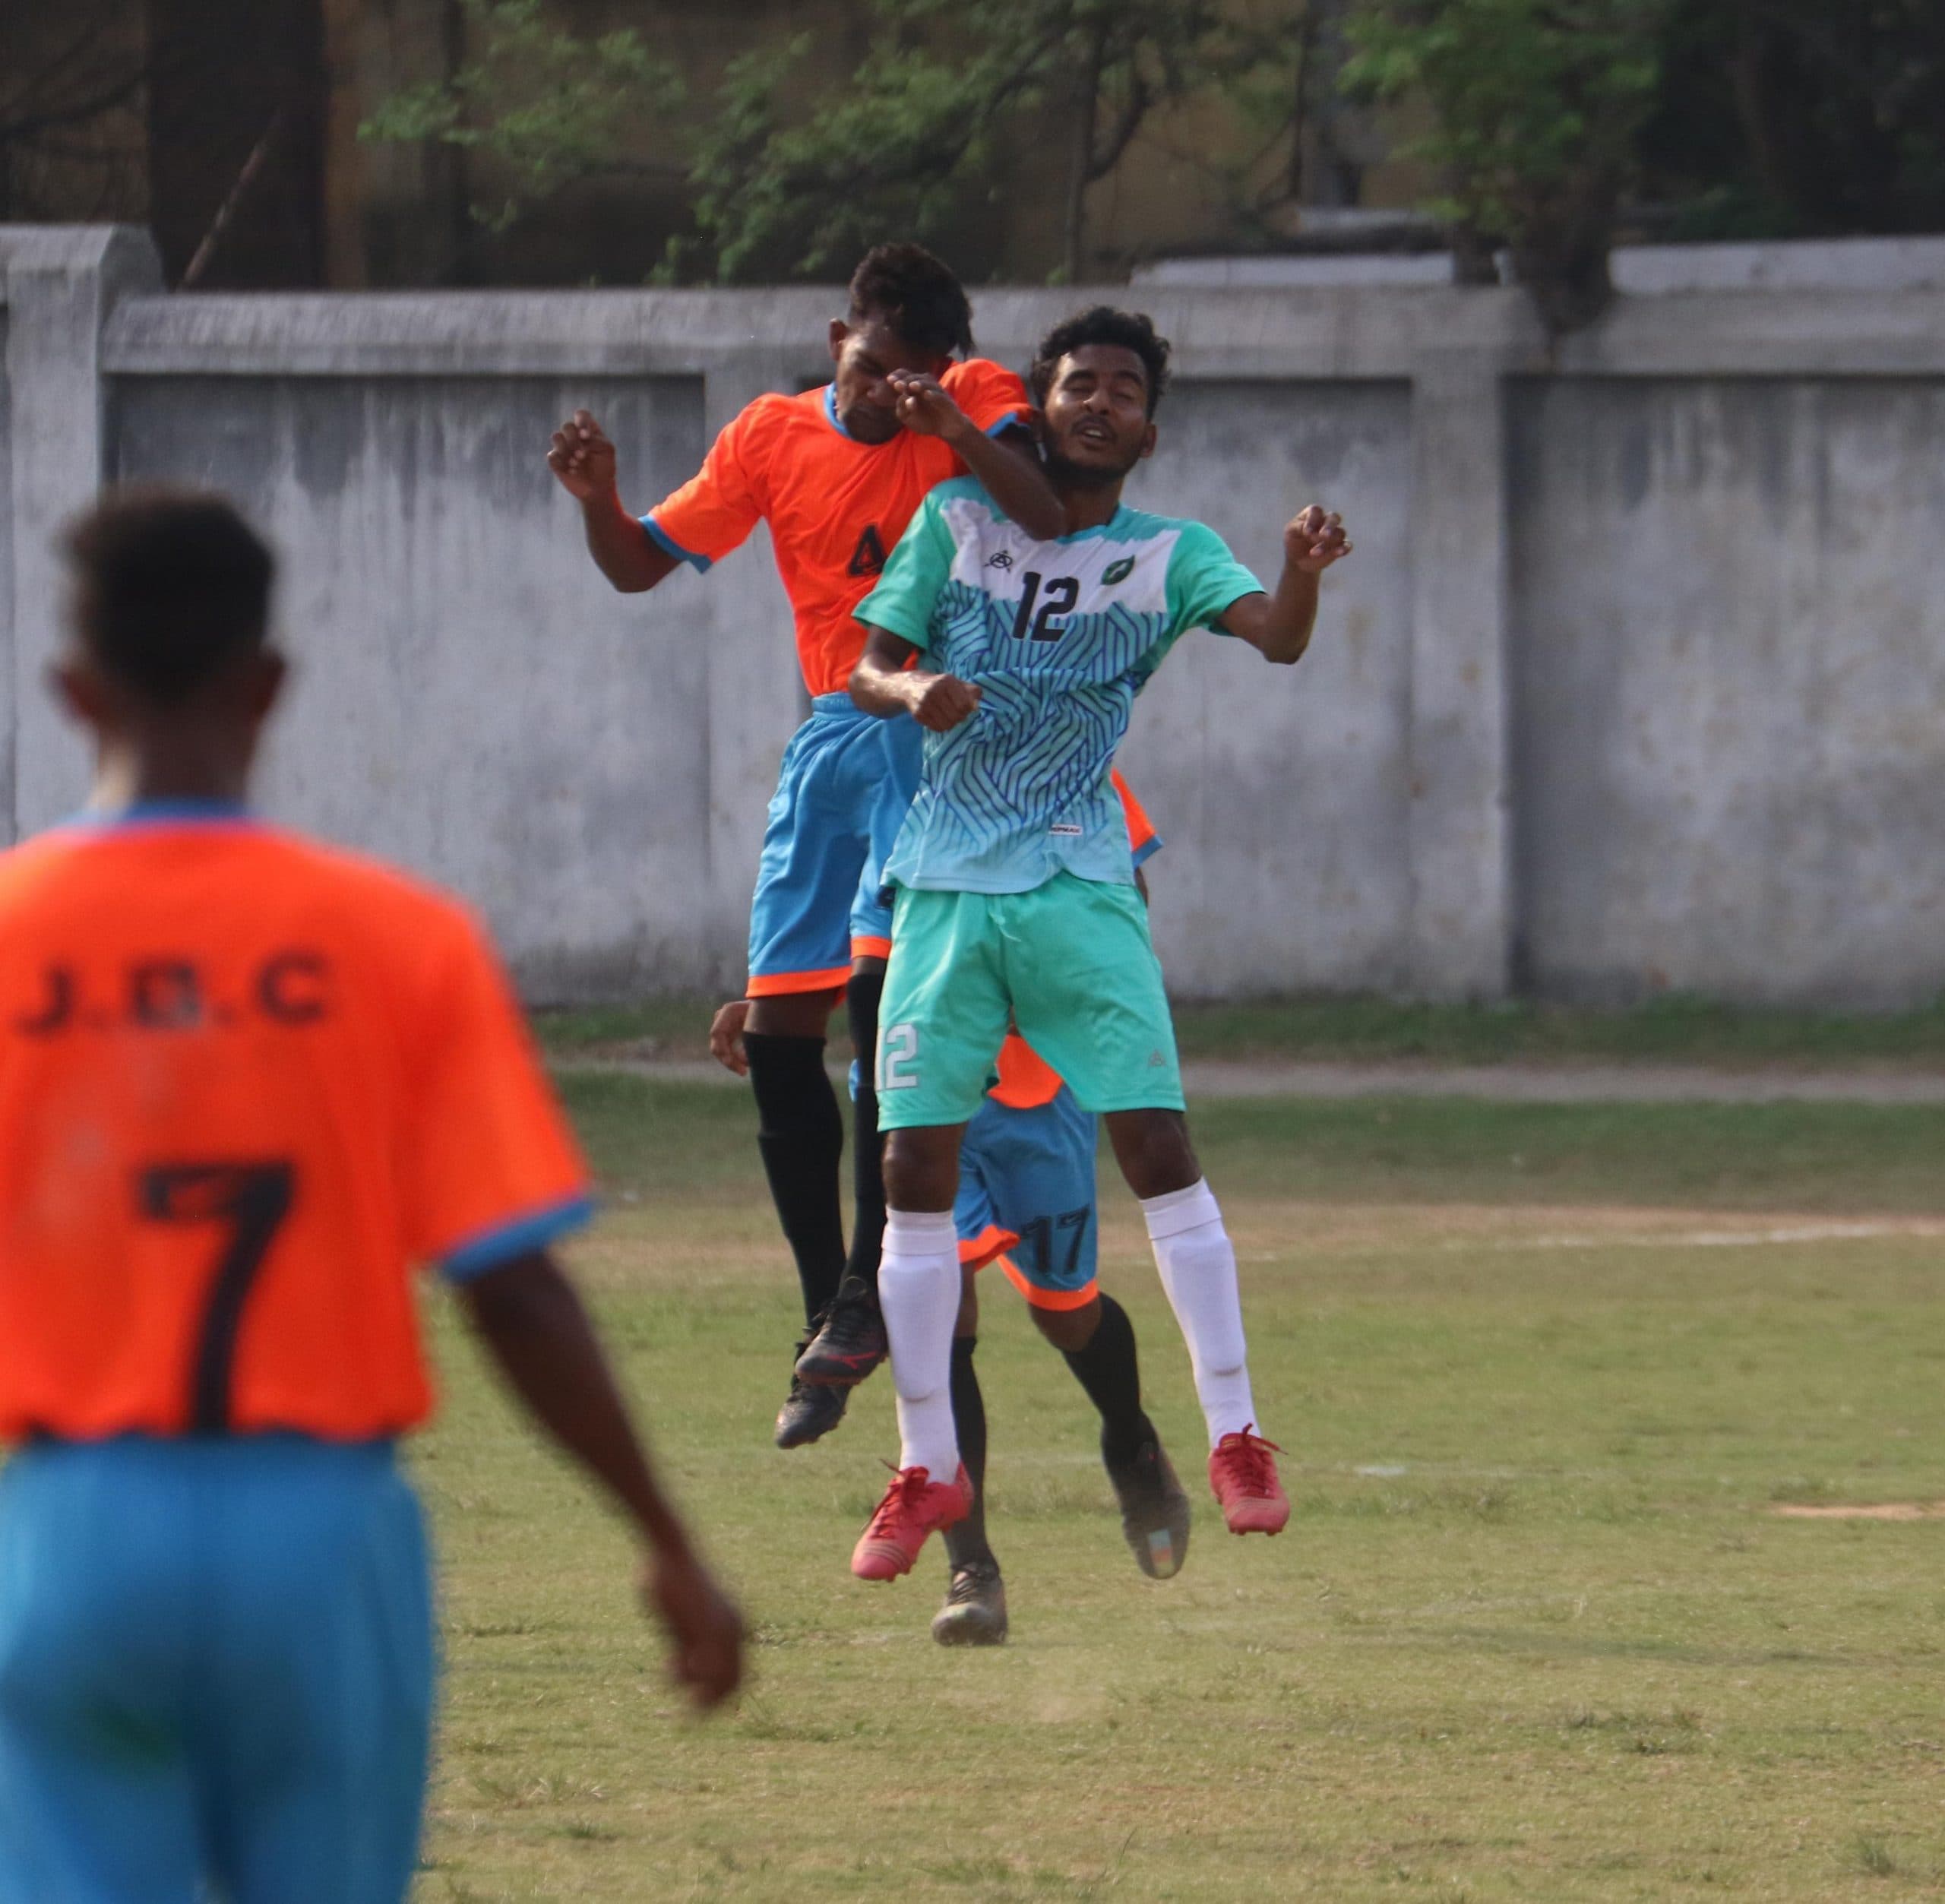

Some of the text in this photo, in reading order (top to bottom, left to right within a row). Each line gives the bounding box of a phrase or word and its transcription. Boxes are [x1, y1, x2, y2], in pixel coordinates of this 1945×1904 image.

[1012, 571, 1079, 641] 12
[1020, 1205, 1090, 1275] 17
[141, 1158, 293, 1430] 7
